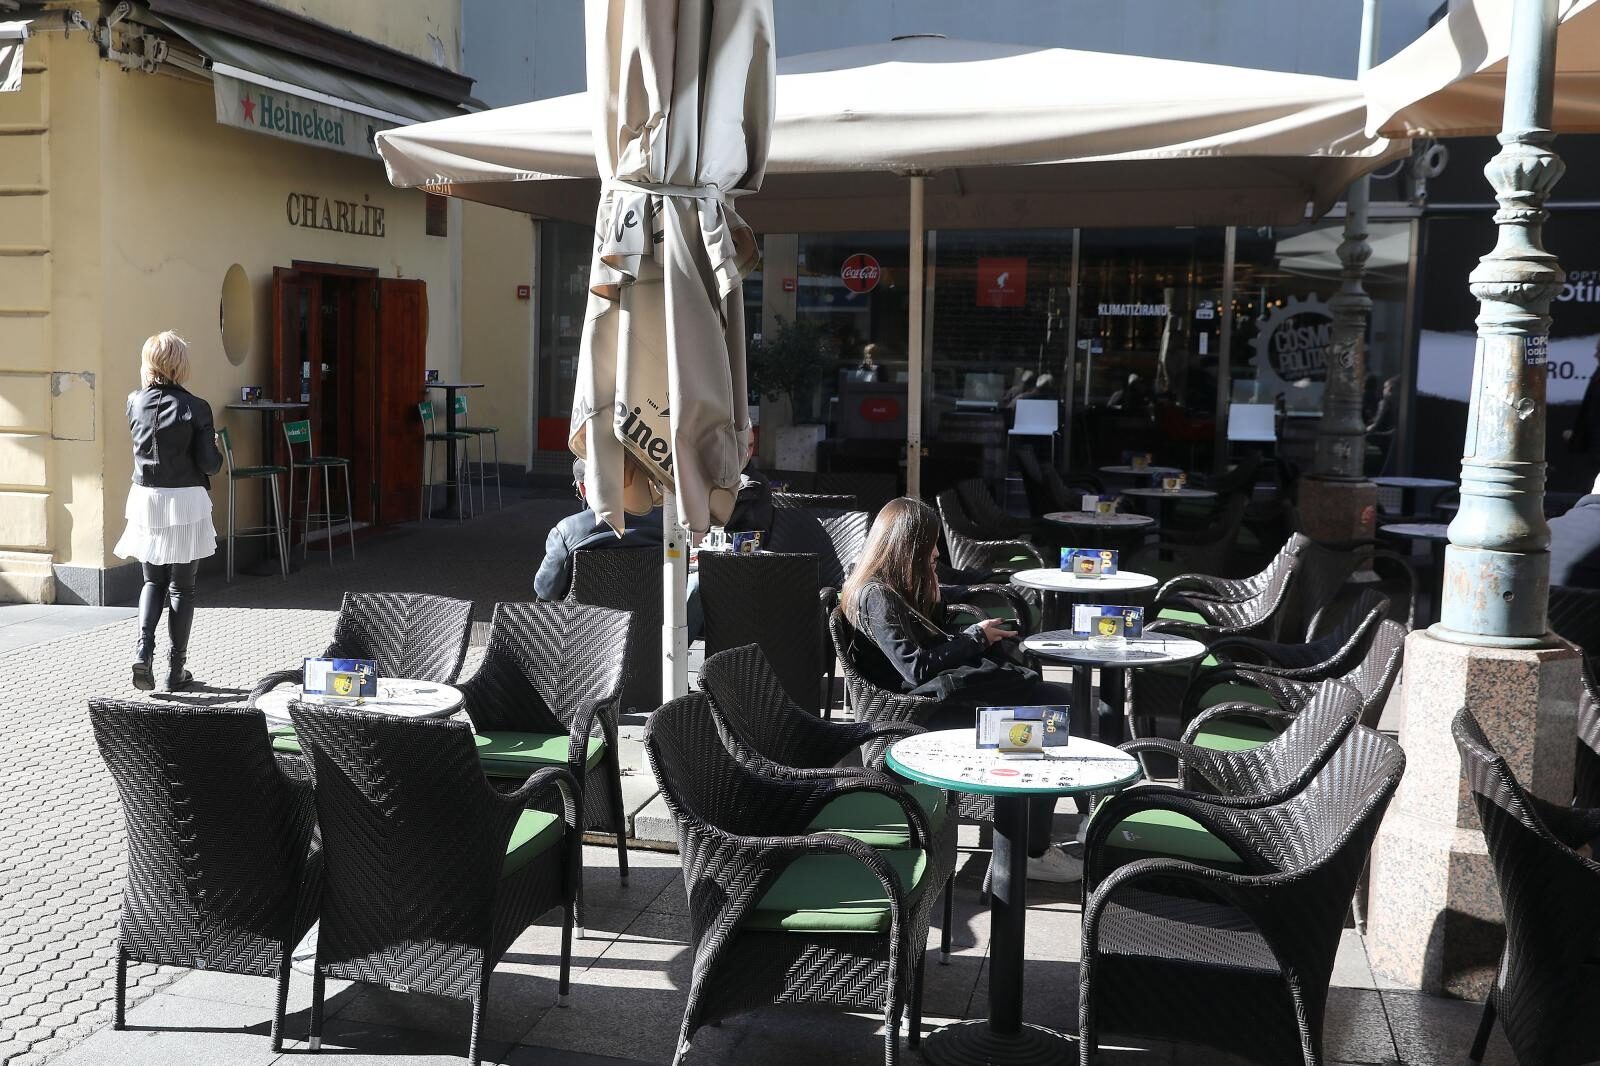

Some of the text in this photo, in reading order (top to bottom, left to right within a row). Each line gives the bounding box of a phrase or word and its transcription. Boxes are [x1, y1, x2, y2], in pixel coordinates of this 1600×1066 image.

[259, 93, 346, 146] Heineken
[1097, 303, 1169, 316] KLIMATIZIRANO
[1279, 349, 1329, 374] POLITA
